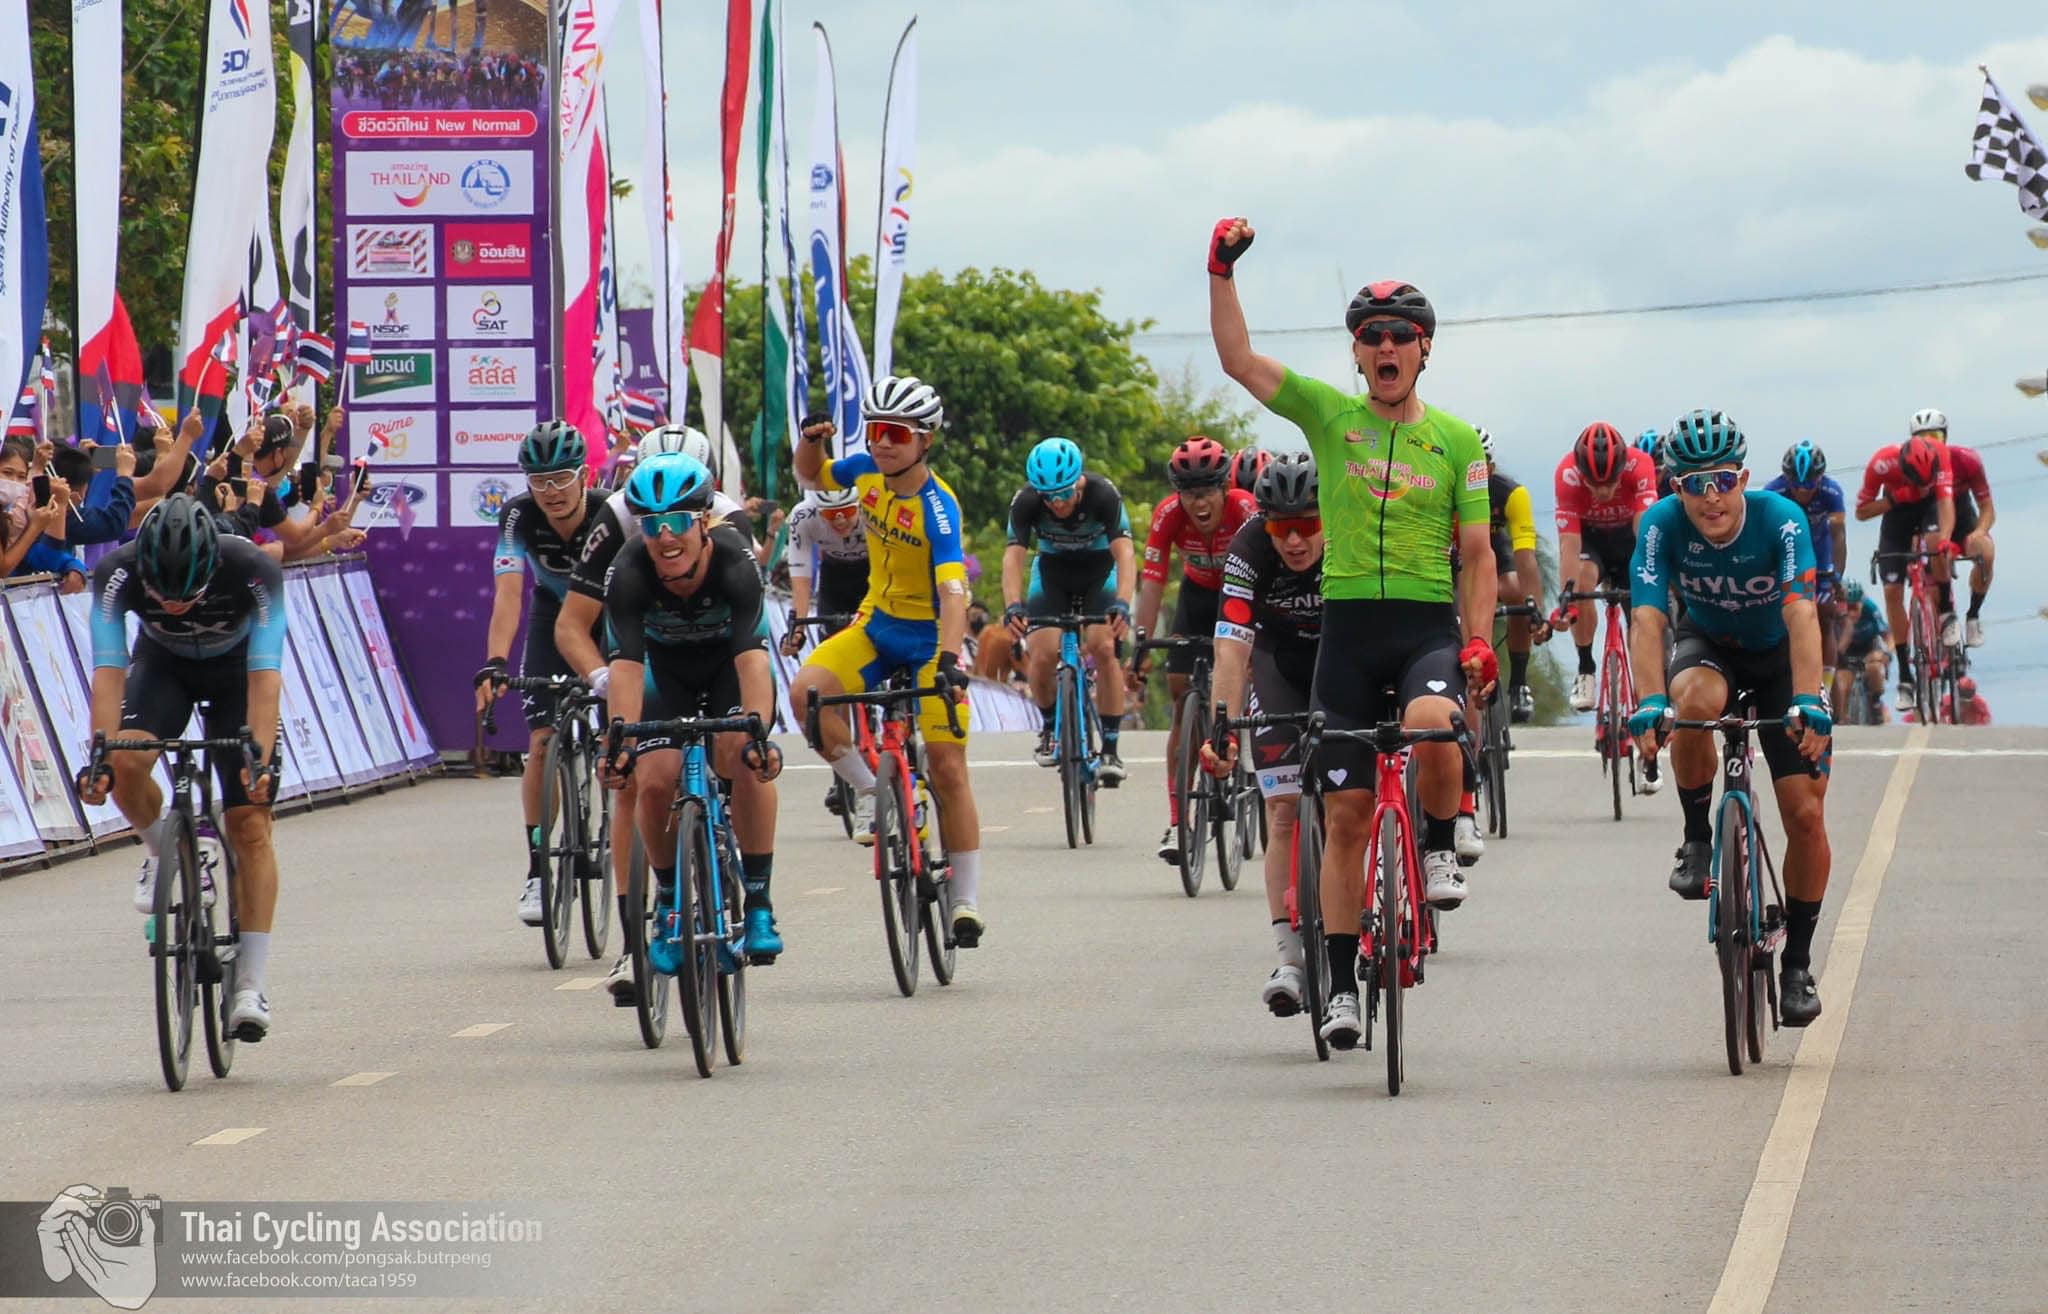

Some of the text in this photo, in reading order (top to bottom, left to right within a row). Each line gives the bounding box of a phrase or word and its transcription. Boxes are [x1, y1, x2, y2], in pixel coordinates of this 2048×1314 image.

[357, 117, 521, 132] ชีวิตวิถีใหม่ New Normal
[369, 172, 451, 186] THAILAND
[372, 324, 410, 334] NSDF
[476, 319, 509, 331] SAT
[1679, 571, 1776, 596] HYLO
